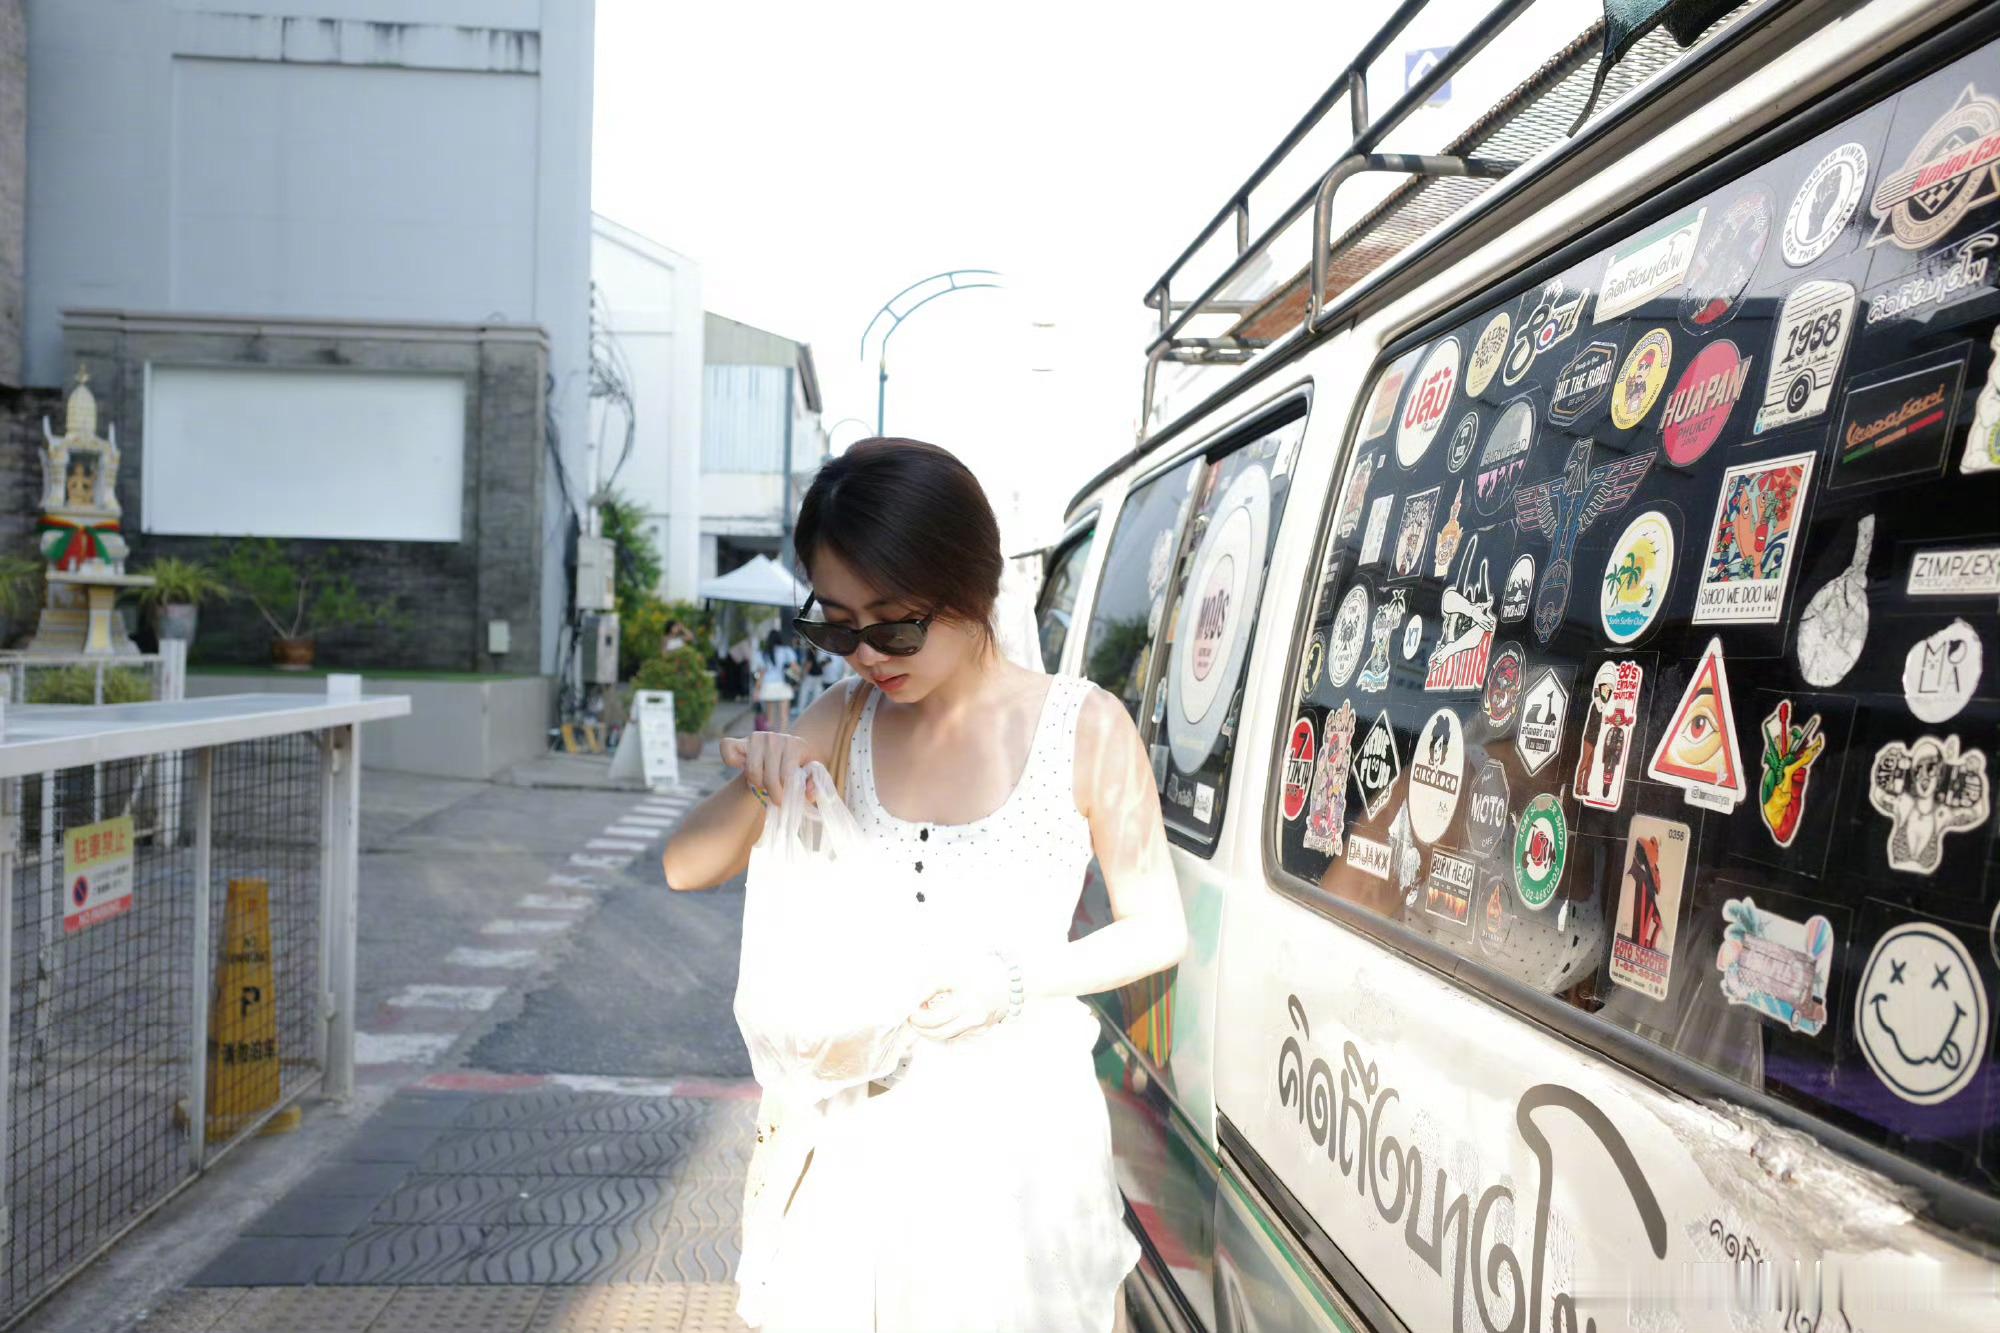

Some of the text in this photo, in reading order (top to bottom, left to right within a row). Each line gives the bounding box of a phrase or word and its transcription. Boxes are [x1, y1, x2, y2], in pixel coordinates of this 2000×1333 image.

[1841, 145, 1866, 178] VINTAGE
[1784, 202, 1855, 260] KEEP THE FAITH
[1779, 308, 1842, 367] 1958
[1554, 377, 1571, 404] HIT
[1570, 371, 1587, 396] THE
[1586, 359, 1613, 391] ROAD
[1659, 359, 1750, 431] HUAPAN
[1677, 416, 1714, 438] PHUKET
[1701, 583, 1779, 606] SHOO WE DOO WA
[1413, 766, 1458, 792] CIRCOLOCO
[1471, 792, 1505, 828] MOTO
[1432, 853, 1473, 887] BURN HEAD
[1635, 945, 1668, 975] SCOOTER
